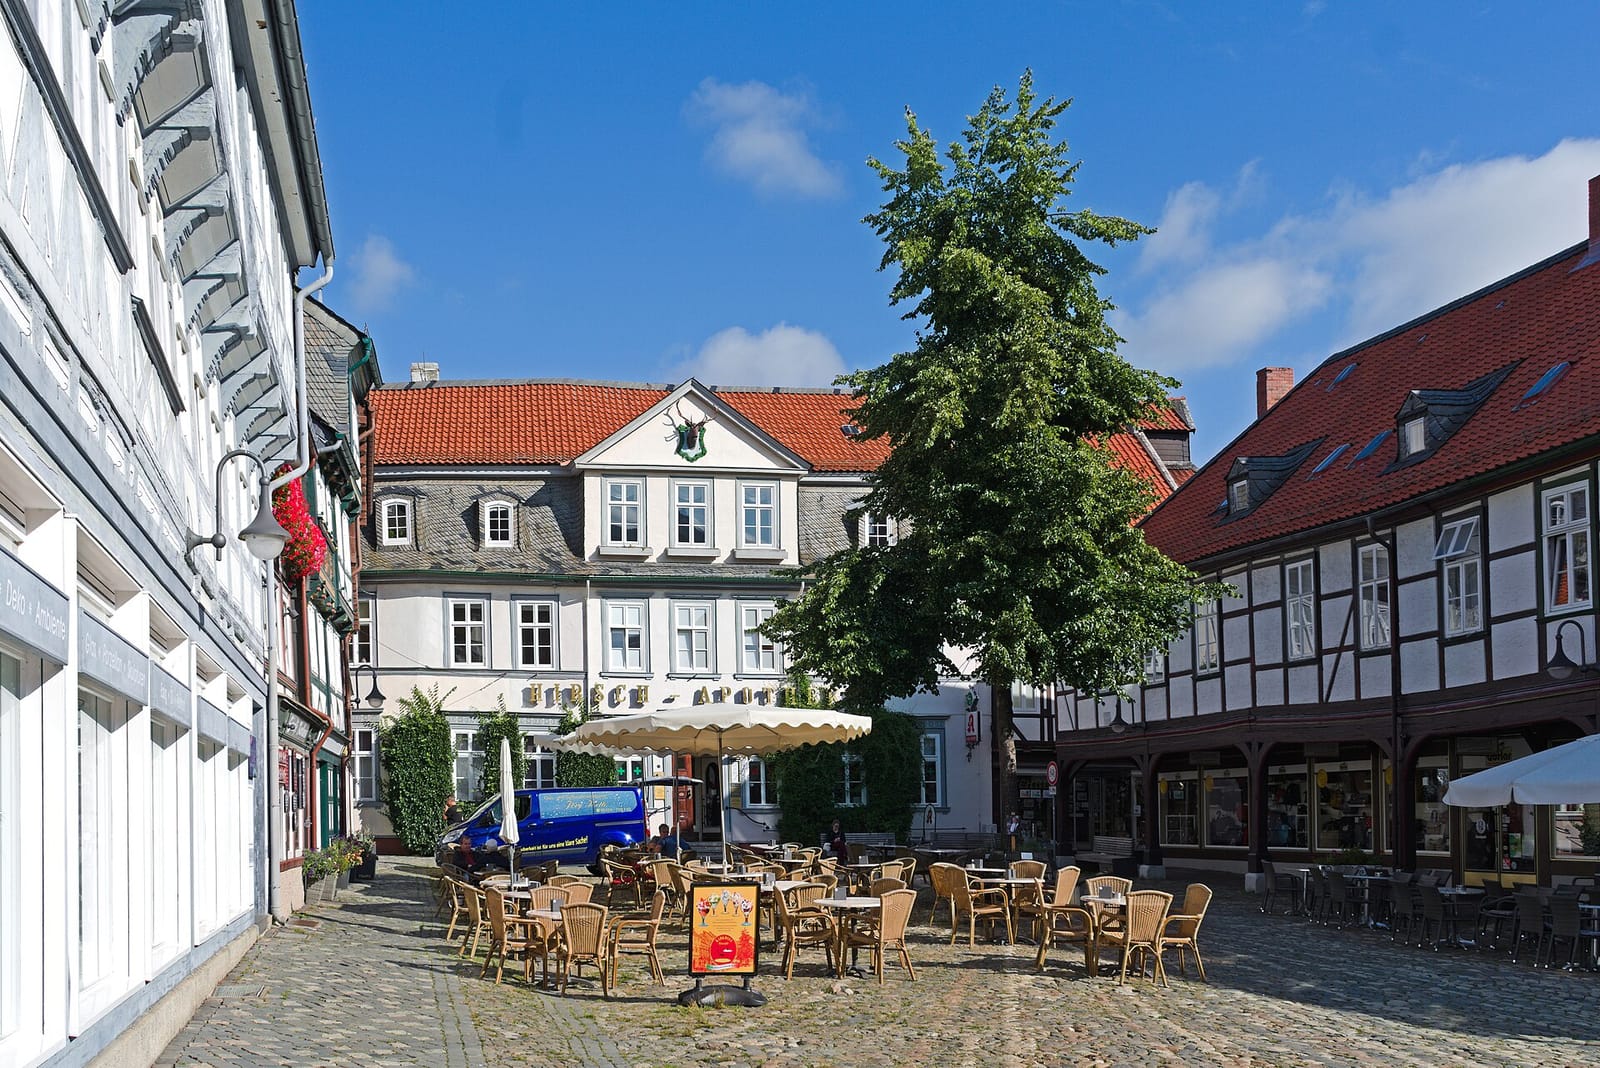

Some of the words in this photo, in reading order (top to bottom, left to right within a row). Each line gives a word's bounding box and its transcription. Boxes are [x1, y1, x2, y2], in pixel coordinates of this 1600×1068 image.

[6, 579, 26, 616] Deko
[35, 600, 66, 640] Ambiente
[529, 682, 650, 704] HIRSCH
[697, 684, 839, 709] APOTHEK
